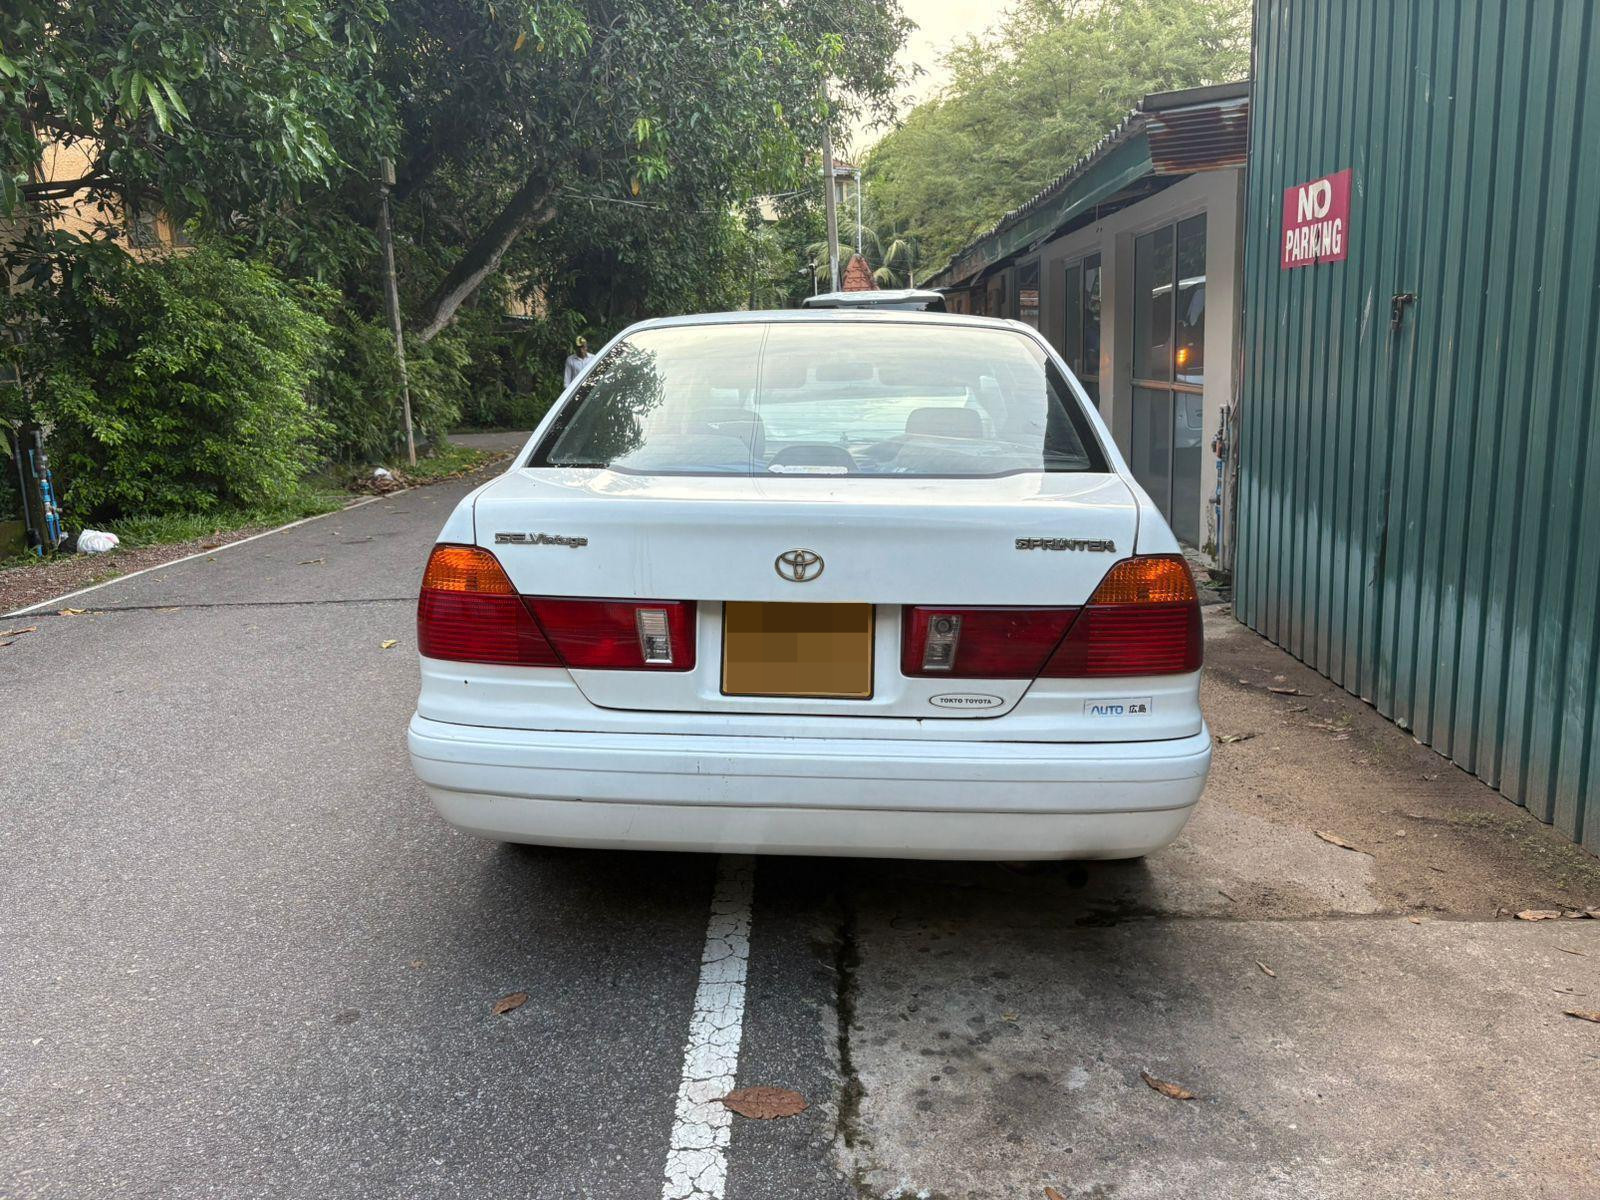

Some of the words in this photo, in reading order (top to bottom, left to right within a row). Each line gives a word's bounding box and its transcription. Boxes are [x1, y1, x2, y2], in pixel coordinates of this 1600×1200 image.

[1297, 179, 1332, 223] NO
[1285, 217, 1342, 263] PARKING
[1015, 537, 1117, 553] SPRINTER
[1091, 705, 1124, 715] AUTO
[1128, 704, 1147, 713] 広島
